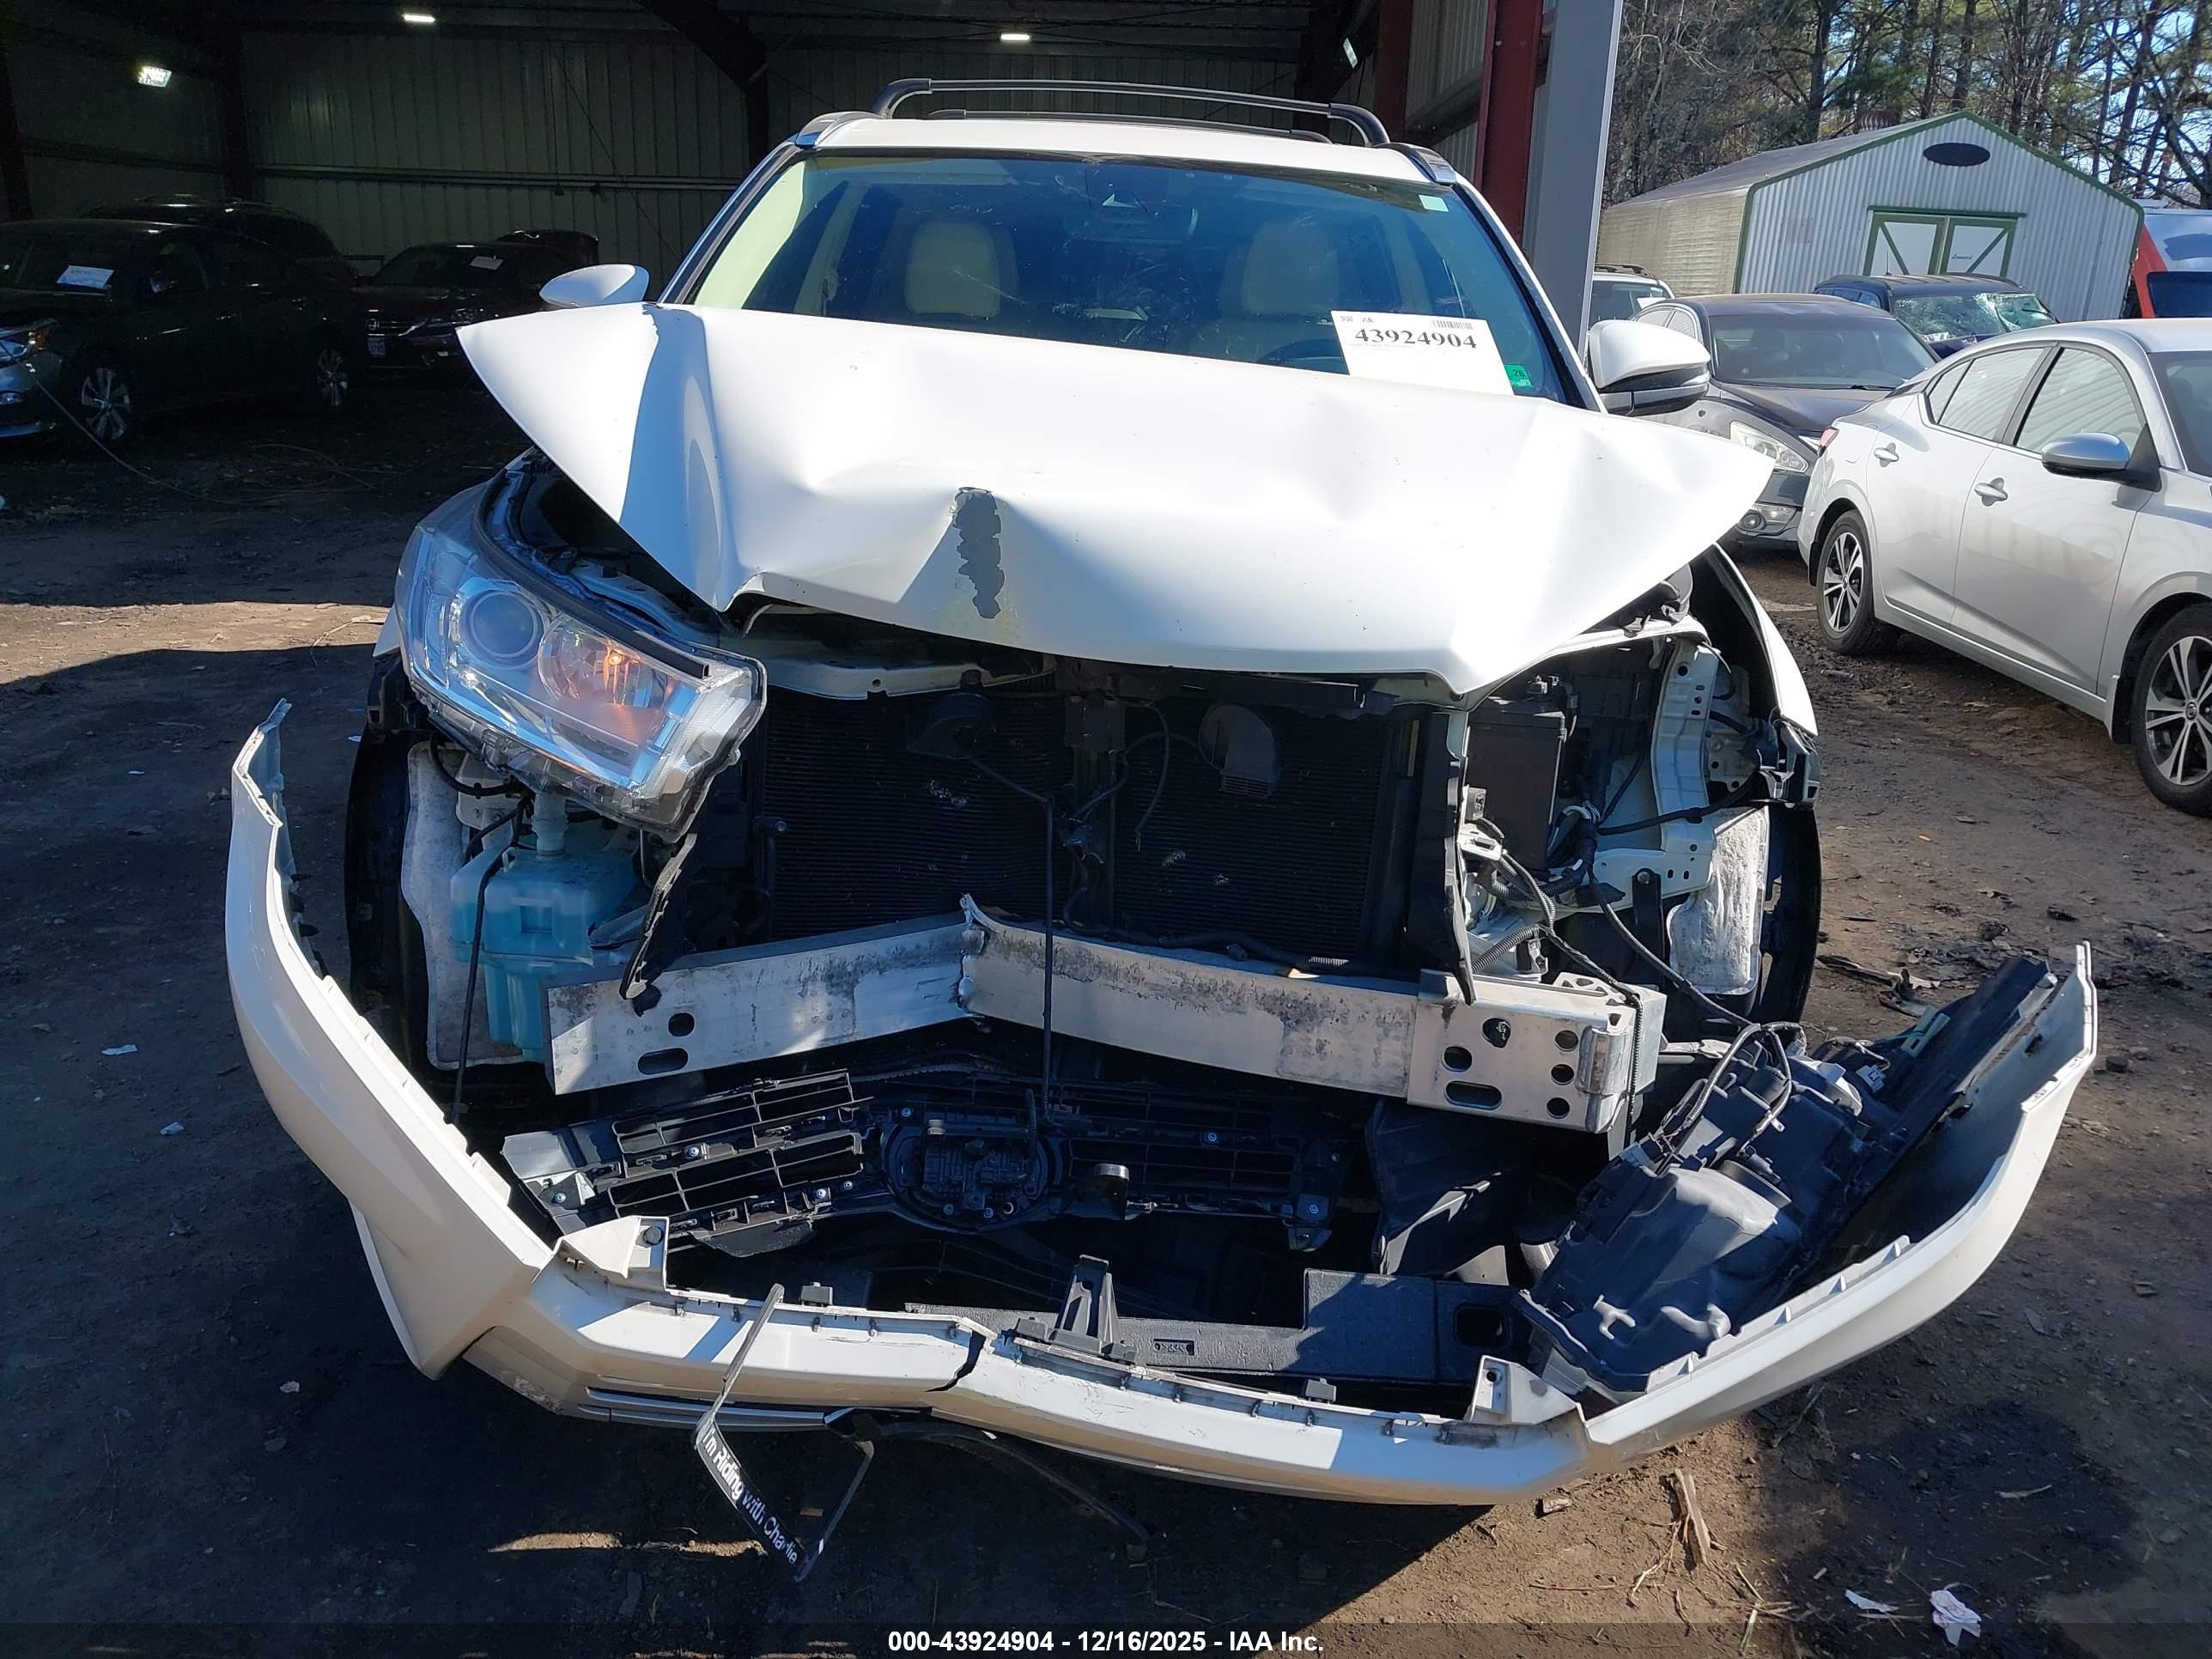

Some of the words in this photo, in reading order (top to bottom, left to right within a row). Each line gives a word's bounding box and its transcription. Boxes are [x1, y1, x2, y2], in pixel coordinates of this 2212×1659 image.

[1355, 328, 1476, 349] 43924904
[702, 1428, 718, 1456] I'm
[713, 1446, 744, 1500] Riding
[742, 1491, 766, 1525] with
